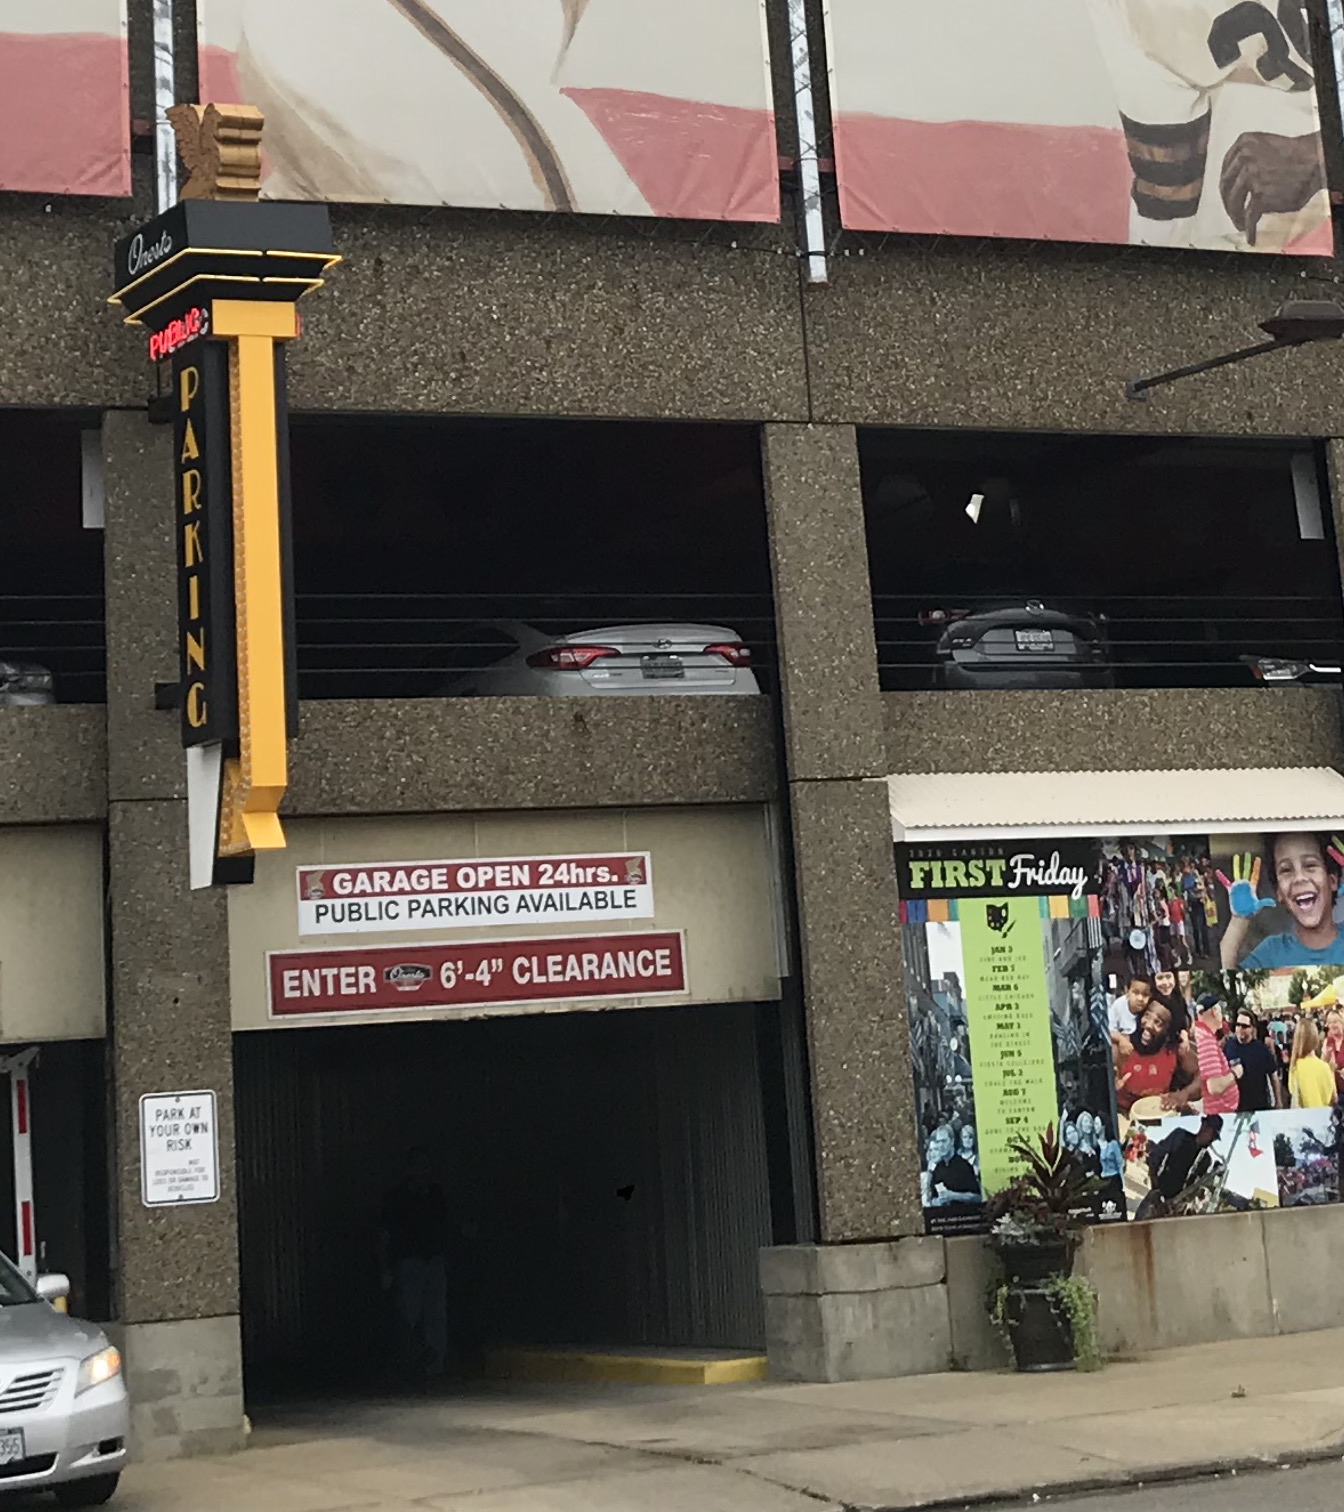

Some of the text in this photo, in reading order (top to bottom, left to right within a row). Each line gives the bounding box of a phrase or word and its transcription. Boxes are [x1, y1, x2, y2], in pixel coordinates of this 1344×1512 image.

[149, 307, 202, 361] PUBLIC
[180, 366, 208, 728] PARKING
[332, 867, 449, 895] GARAGE
[456, 865, 530, 889] OPEN
[538, 862, 618, 885] 24hrs.
[909, 851, 1088, 900] FIRST Friday
[315, 889, 636, 924] PUBLIC PARKING AVAILABLE
[283, 965, 376, 999] ENTER
[512, 948, 672, 985] CLEARANCE
[149, 1122, 208, 1137] YOUR OWN
[156, 1106, 201, 1121] PARK AT
[166, 1139, 192, 1151] RISK
